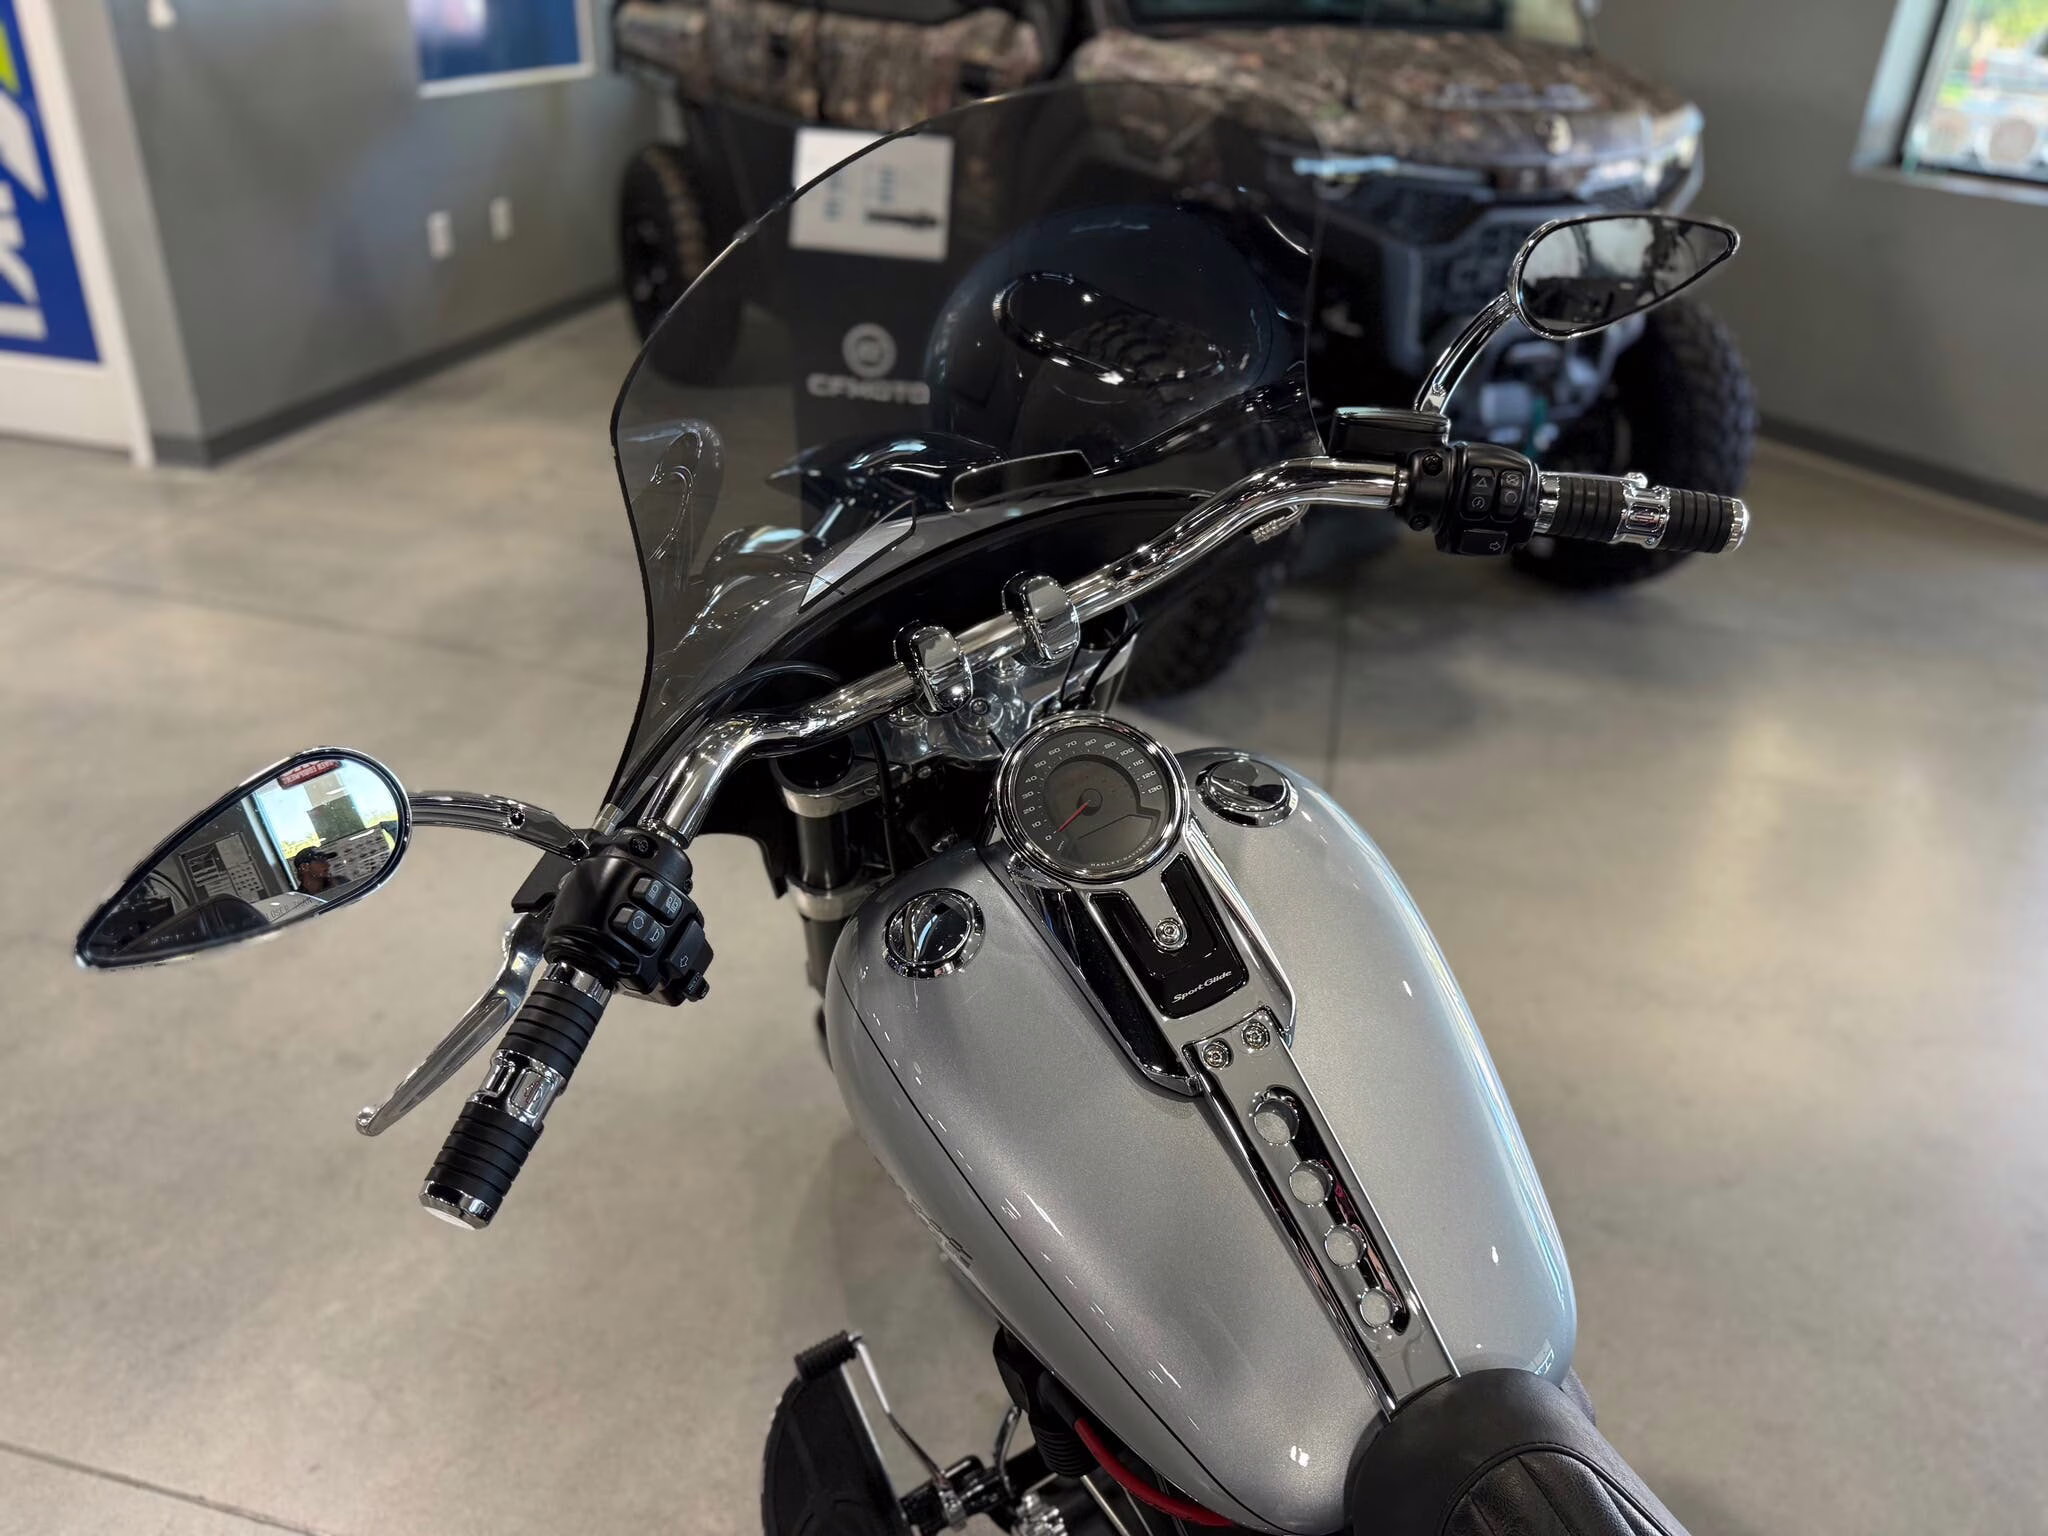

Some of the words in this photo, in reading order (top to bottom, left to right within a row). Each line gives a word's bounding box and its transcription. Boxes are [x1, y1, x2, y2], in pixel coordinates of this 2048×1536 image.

[1065, 740, 1077, 748] 70
[1084, 738, 1097, 746] 80
[1104, 741, 1116, 749] 90
[1048, 747, 1061, 755] 60
[1120, 747, 1134, 756] 100
[1034, 760, 1047, 768] 50
[1132, 759, 1144, 767] 110
[1142, 770, 1156, 779] 120
[1025, 775, 1037, 783] 40
[1148, 784, 1162, 793] 130
[1021, 791, 1034, 799] 30
[1023, 806, 1036, 815] 20
[1171, 983, 1204, 1004] Sport
[1203, 970, 1232, 987] Glide
